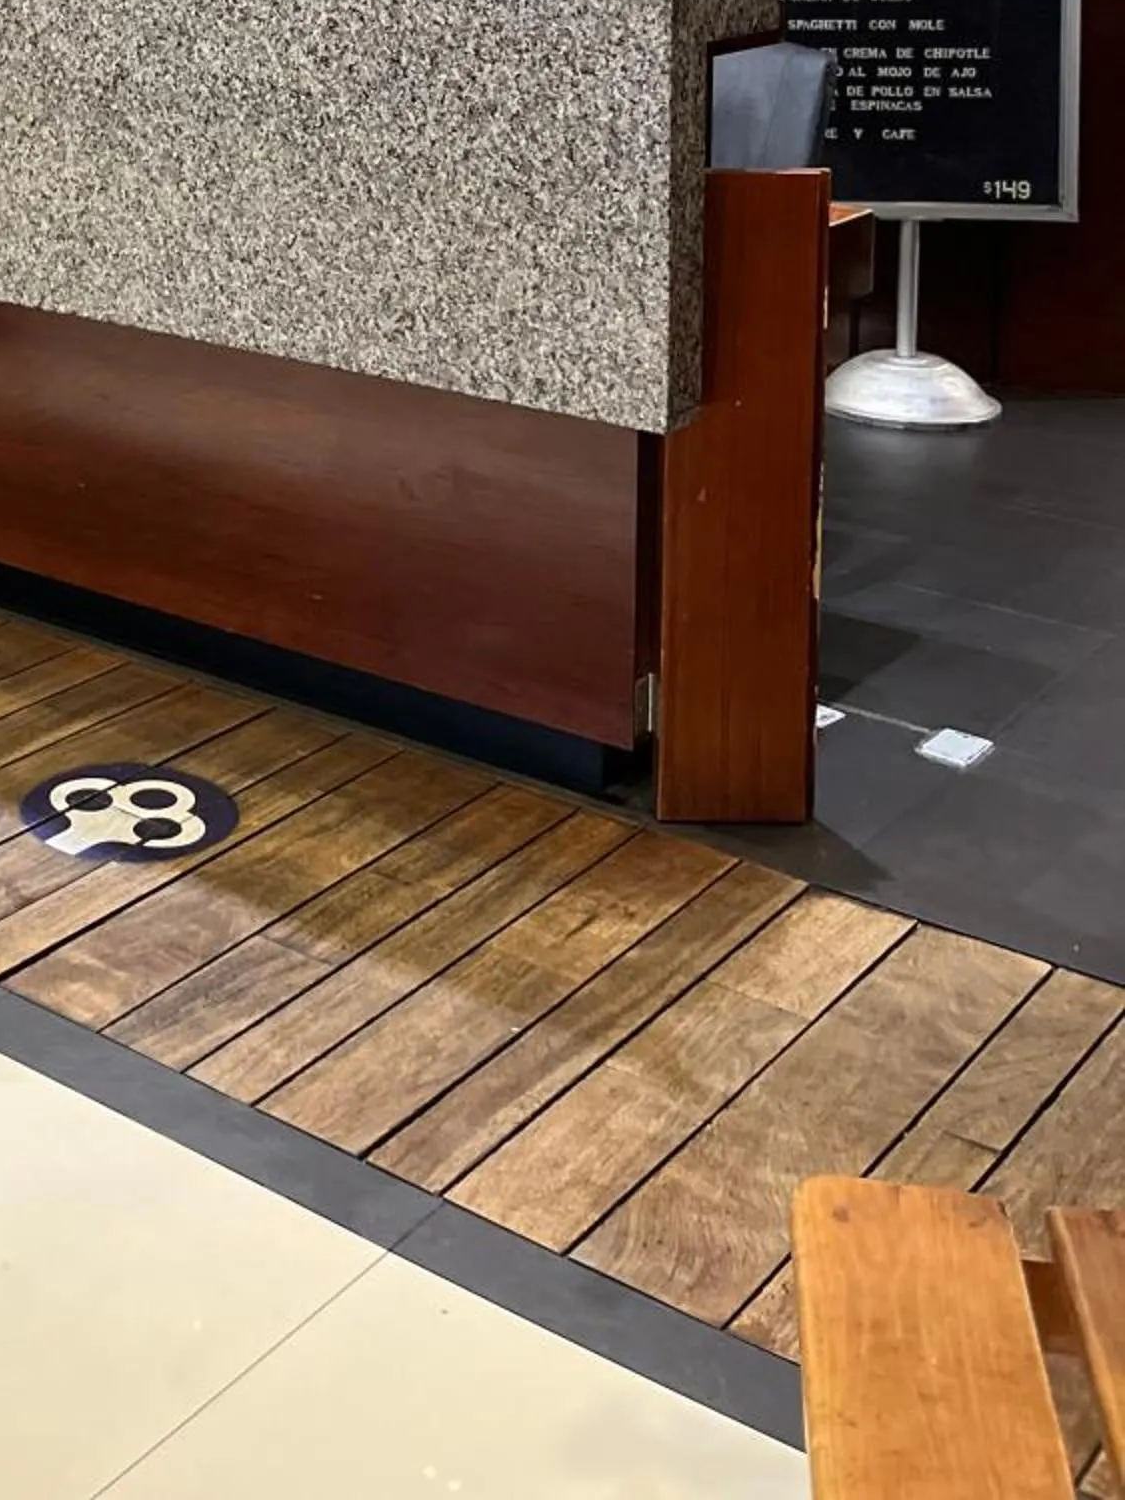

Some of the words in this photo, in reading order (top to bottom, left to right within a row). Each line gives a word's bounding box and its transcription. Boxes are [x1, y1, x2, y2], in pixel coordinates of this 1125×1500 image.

[787, 18, 858, 31] SPAGHETTI
[868, 18, 896, 31] CON
[908, 18, 945, 31] MOLE
[843, 47, 888, 60] CREMA
[896, 47, 914, 59] DE
[924, 47, 991, 60] CHIPOTLE
[847, 65, 867, 77] AL
[876, 66, 912, 78] MOJO
[923, 66, 941, 78] DE
[950, 66, 977, 78] AJO
[846, 85, 864, 97] DE
[871, 85, 914, 97] POLLO
[923, 86, 940, 97] EN
[948, 86, 992, 98] SALSA
[850, 100, 923, 111] ESPINACAS
[853, 127, 864, 139] Y
[983, 180, 1031, 200] $149
